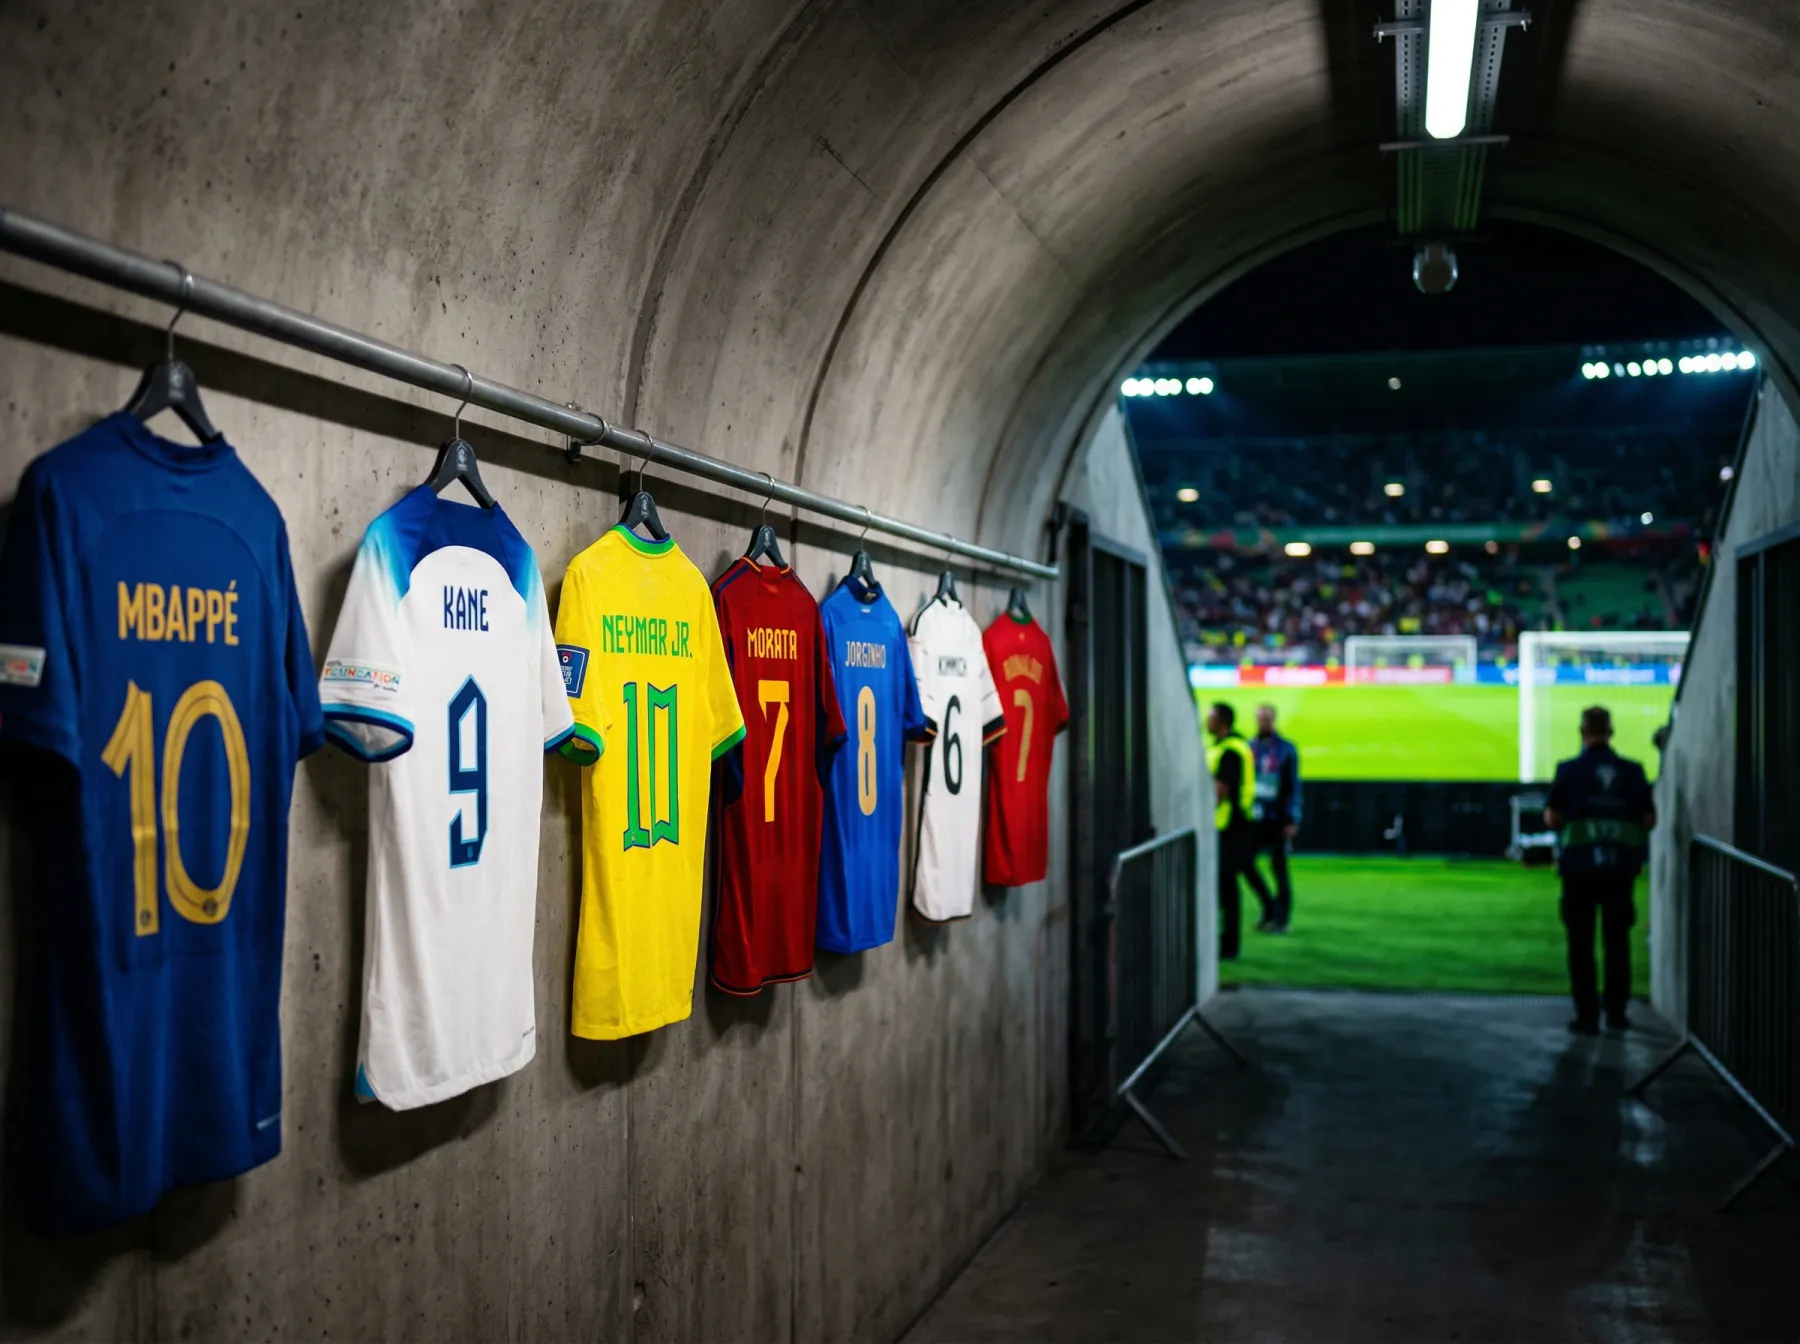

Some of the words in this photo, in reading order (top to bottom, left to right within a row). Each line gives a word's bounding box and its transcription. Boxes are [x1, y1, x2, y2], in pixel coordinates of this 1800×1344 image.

[118, 580, 239, 646] MBAPPÉ
[443, 585, 489, 632] KANE
[602, 614, 668, 656] NEYMAR
[671, 620, 693, 659] JR.
[747, 626, 797, 660] MORATA
[448, 674, 488, 869] 9
[623, 681, 679, 852] 10
[758, 680, 790, 823] 7
[857, 686, 877, 816] 8
[943, 695, 962, 795] 6
[1013, 689, 1033, 783] 7
[101, 679, 251, 937] 10
